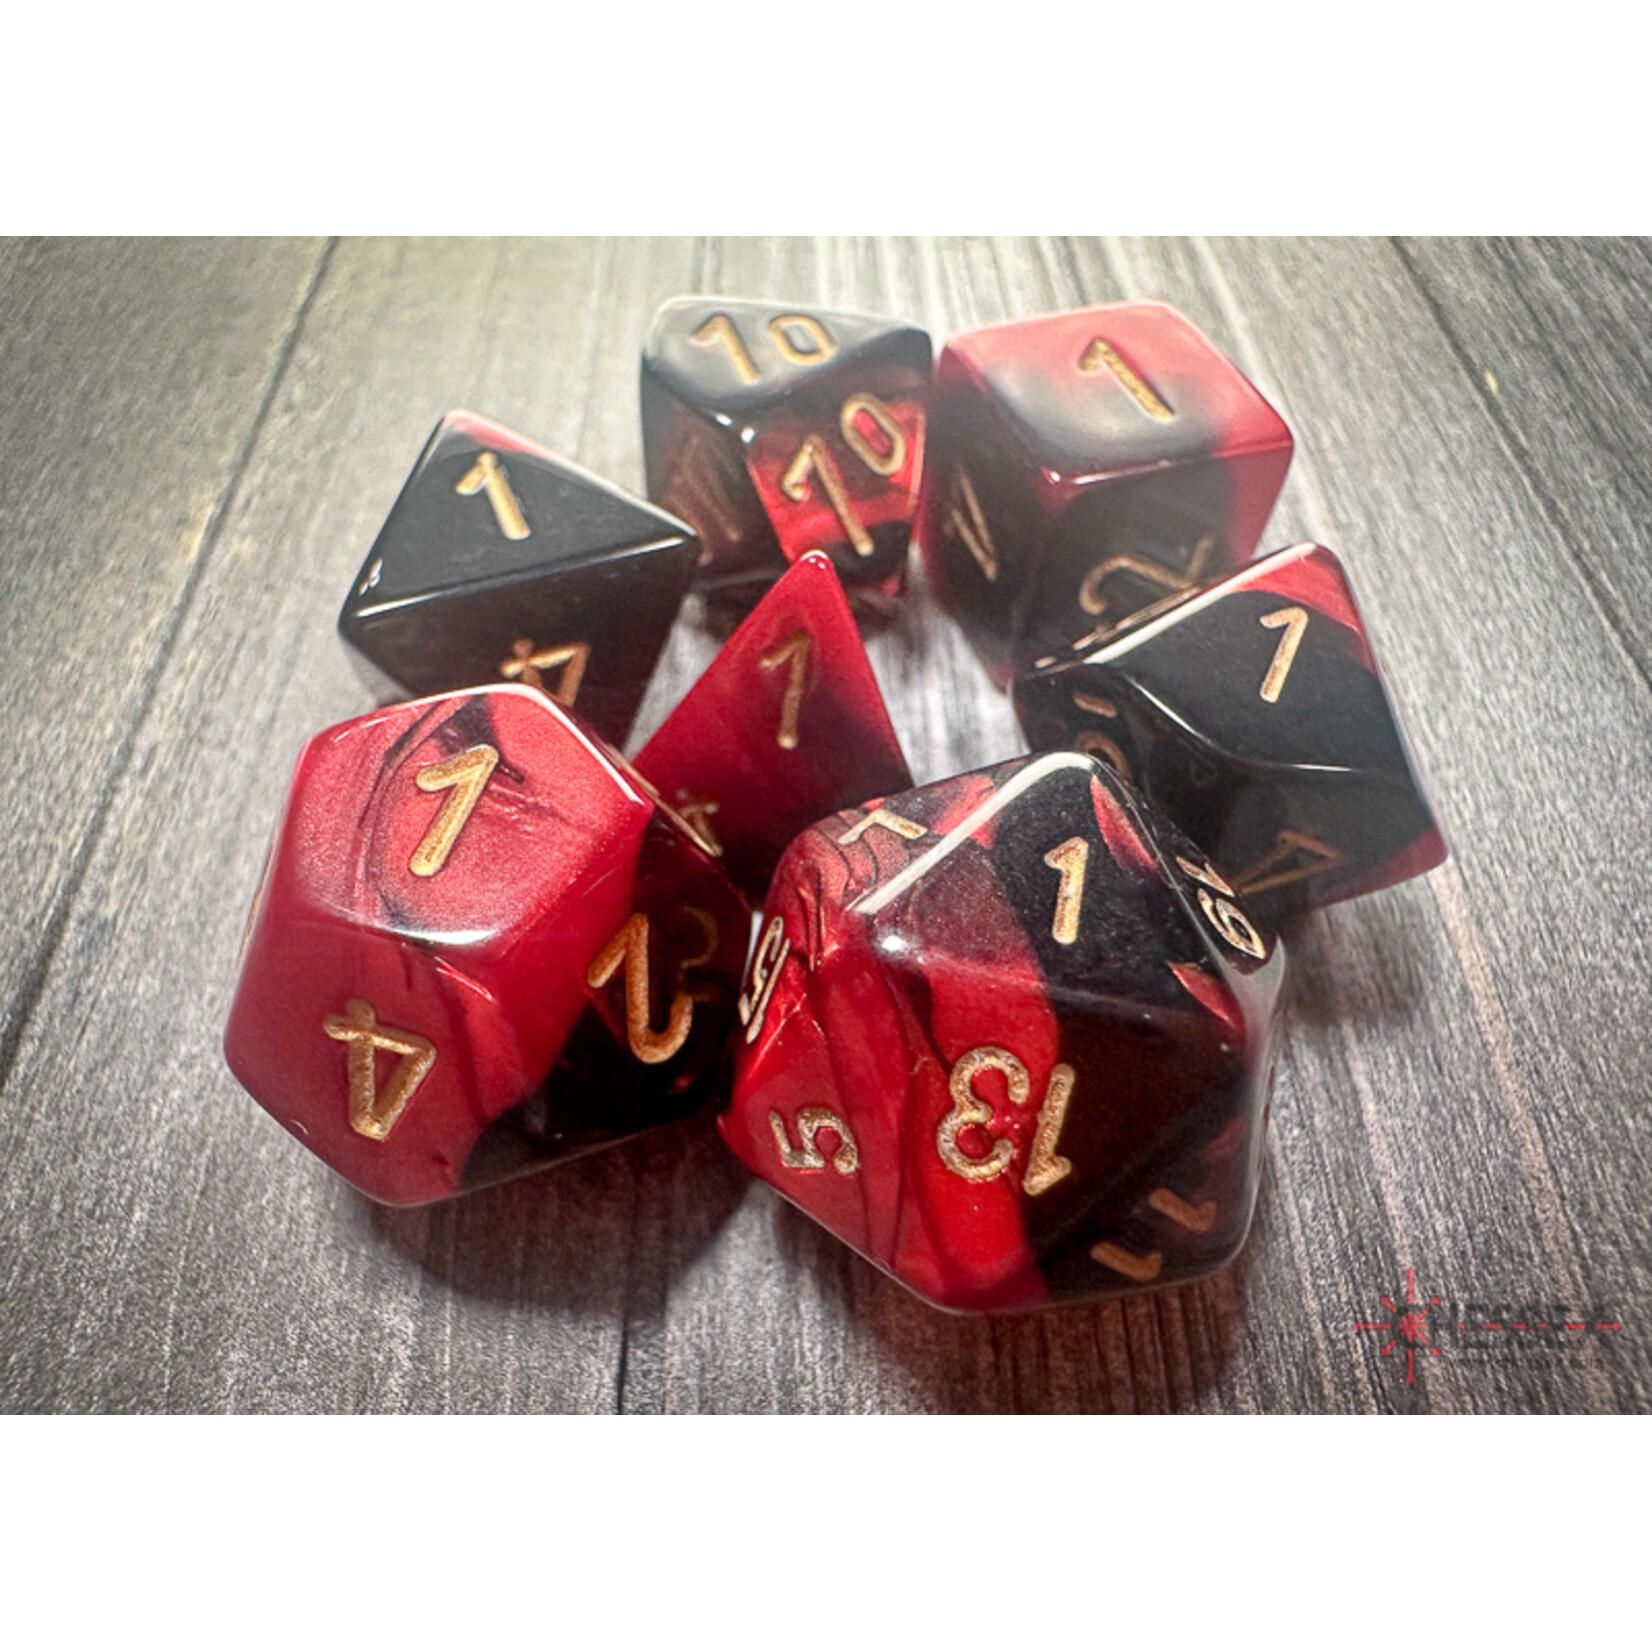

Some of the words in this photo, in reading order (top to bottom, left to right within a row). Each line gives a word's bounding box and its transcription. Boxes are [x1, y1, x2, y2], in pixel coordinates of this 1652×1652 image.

[688, 311, 837, 384] 10
[1077, 334, 1177, 422] 1
[454, 450, 533, 540] 1
[758, 628, 813, 750] 1
[1258, 606, 1309, 704] 1
[408, 743, 501, 878] 1
[1043, 835, 1090, 945] 1
[321, 996, 438, 1143] 4
[936, 1045, 1077, 1196] 13
[768, 1106, 858, 1175] 5
